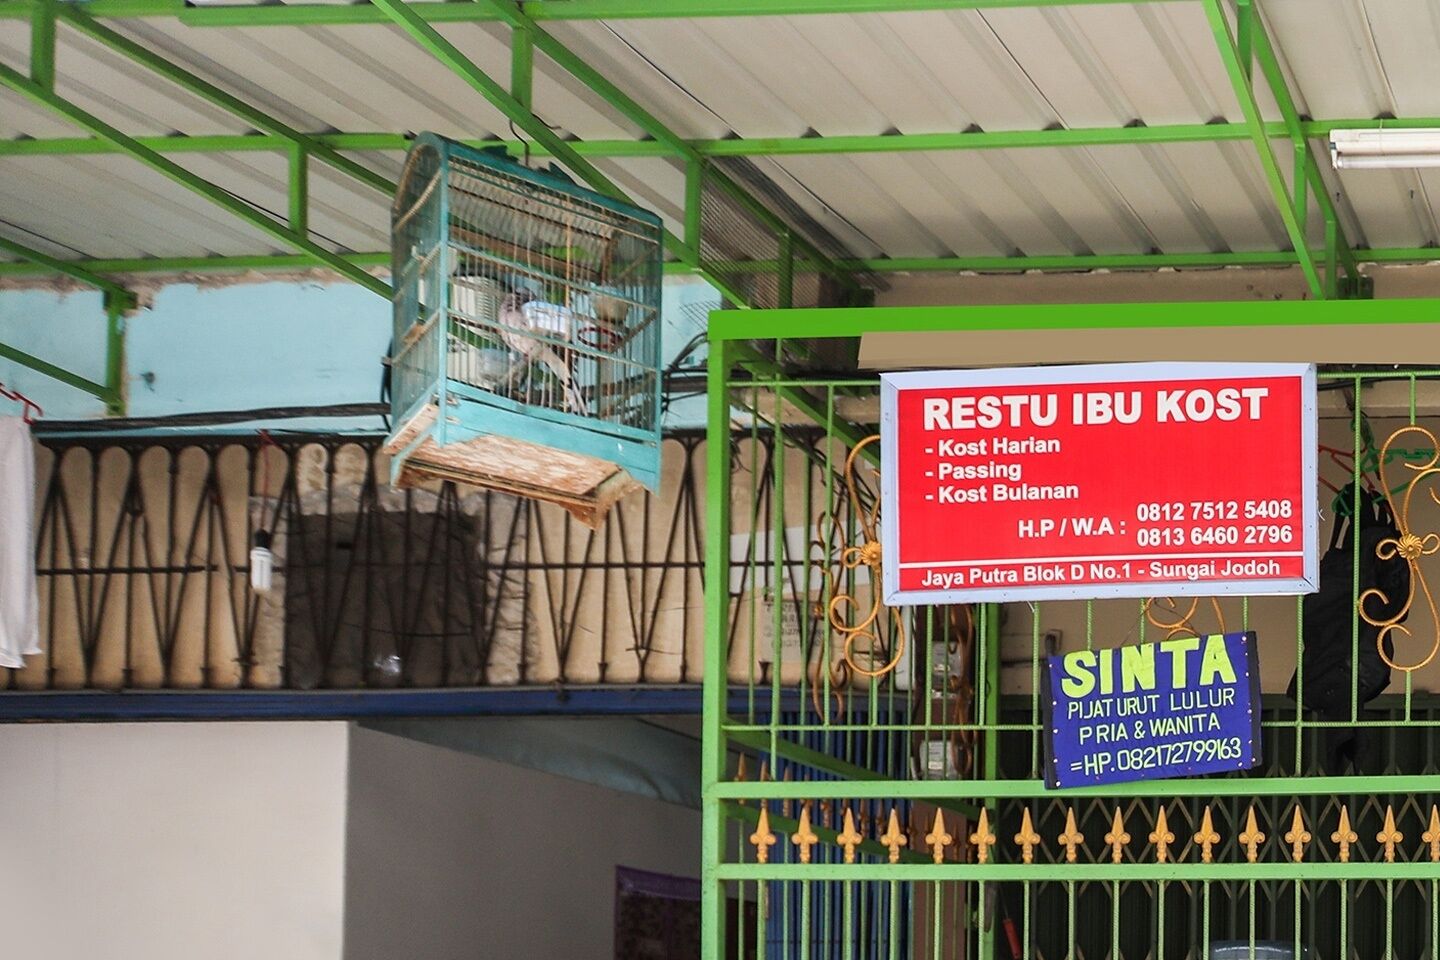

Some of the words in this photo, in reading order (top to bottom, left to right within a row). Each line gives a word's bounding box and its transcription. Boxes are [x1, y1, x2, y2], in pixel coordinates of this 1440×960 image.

[923, 392, 1058, 431] RESTU
[1072, 390, 1142, 426] IBU
[1156, 387, 1269, 423] KOST
[938, 438, 987, 456] Kost
[993, 437, 1060, 455] Harian
[938, 463, 1022, 482] Passing
[938, 485, 987, 503] Kost
[993, 483, 1079, 501] Bulanan
[1136, 503, 1184, 522] 0812
[1190, 501, 1238, 521] 7512
[1244, 500, 1292, 519] 5408
[1018, 519, 1056, 539] H.P
[1072, 517, 1115, 536] W.A
[1136, 528, 1185, 547] 0813
[1190, 527, 1238, 545] 6460
[1244, 525, 1293, 544] 2796
[921, 569, 964, 590] Jaya
[969, 567, 1018, 584] Putra
[1023, 564, 1065, 582] Blok
[1071, 563, 1084, 581] D
[1089, 562, 1131, 580] No.1
[1149, 560, 1215, 581] Sungai
[1220, 559, 1280, 577] Jodoh
[1061, 634, 1237, 698] SINTA
[1068, 698, 1114, 720] PIJAT
[1117, 694, 1160, 715] URUT
[1170, 687, 1235, 712] LULUR
[1079, 724, 1128, 745] PRIA
[1134, 720, 1146, 740] &
[1150, 712, 1221, 737] WANITA
